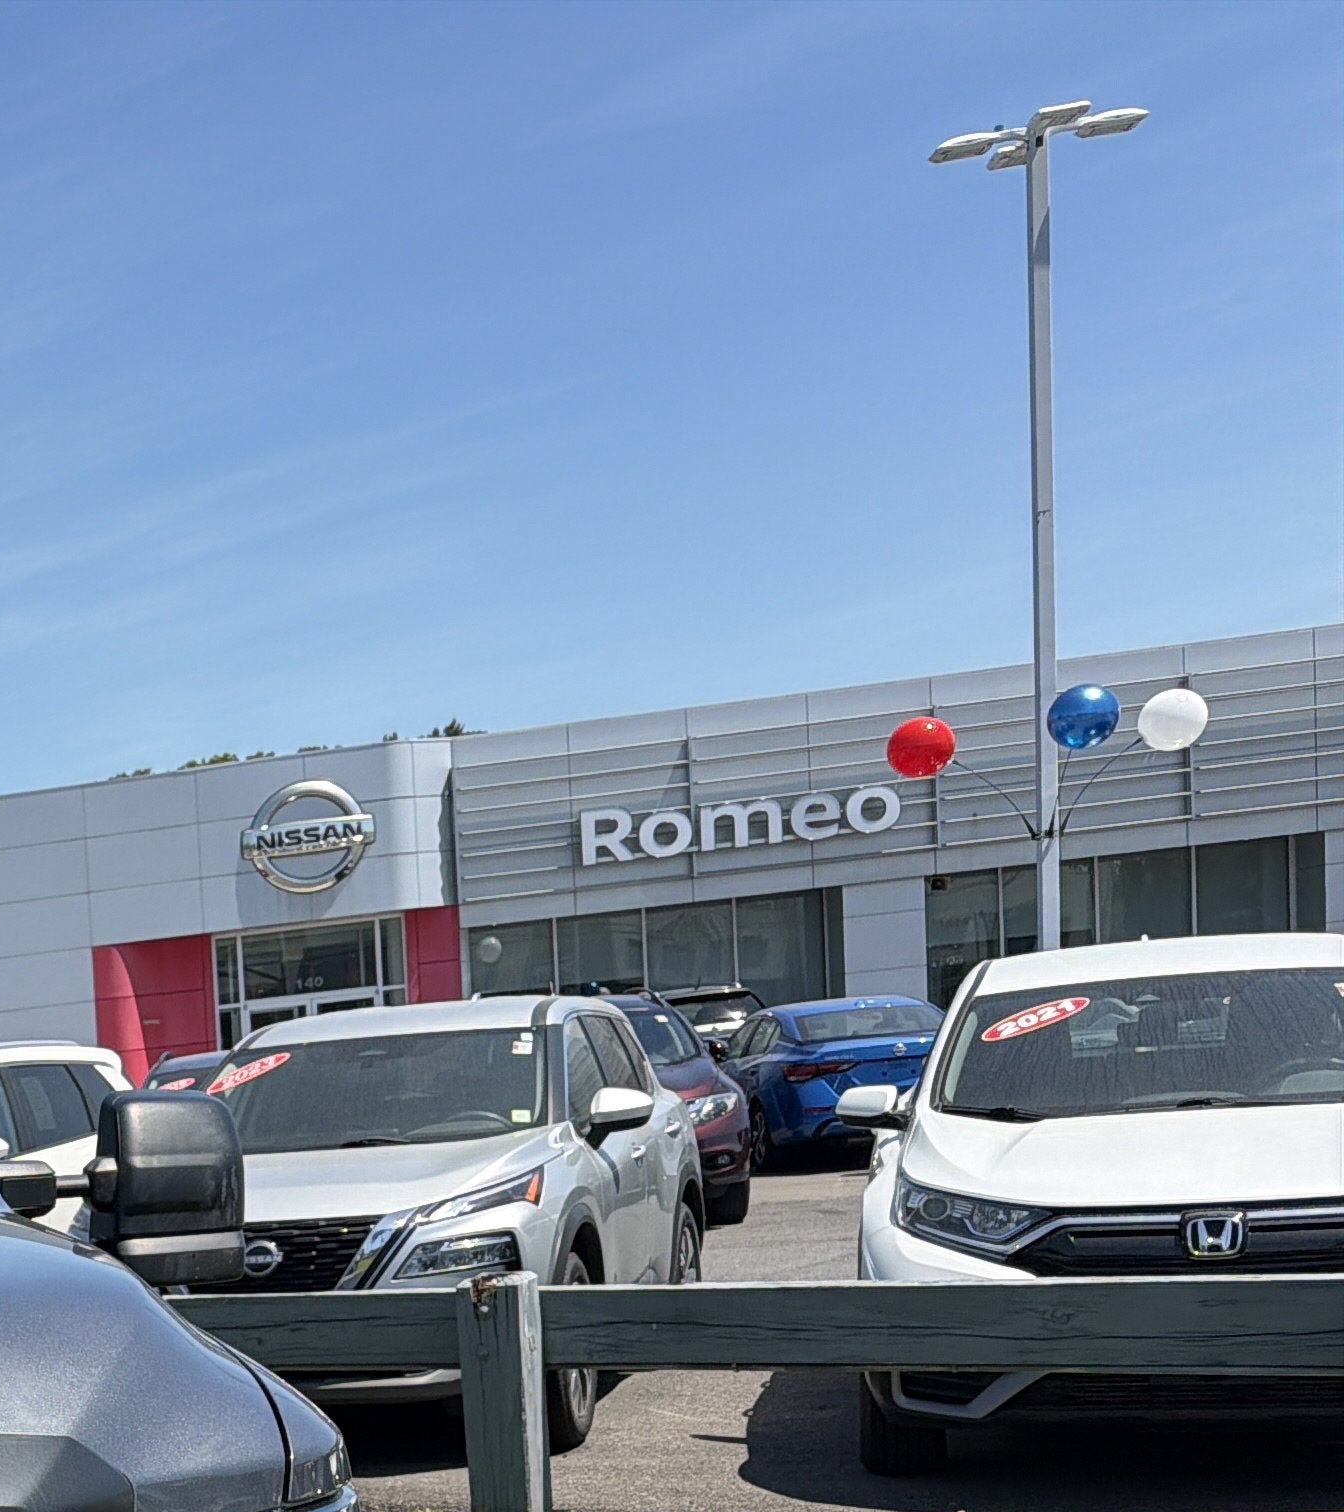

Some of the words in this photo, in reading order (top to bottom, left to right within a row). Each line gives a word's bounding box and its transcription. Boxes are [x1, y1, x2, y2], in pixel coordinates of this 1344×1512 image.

[256, 822, 363, 850] NISSAN
[580, 785, 902, 866] Romeo
[995, 999, 1076, 1038] 2021
